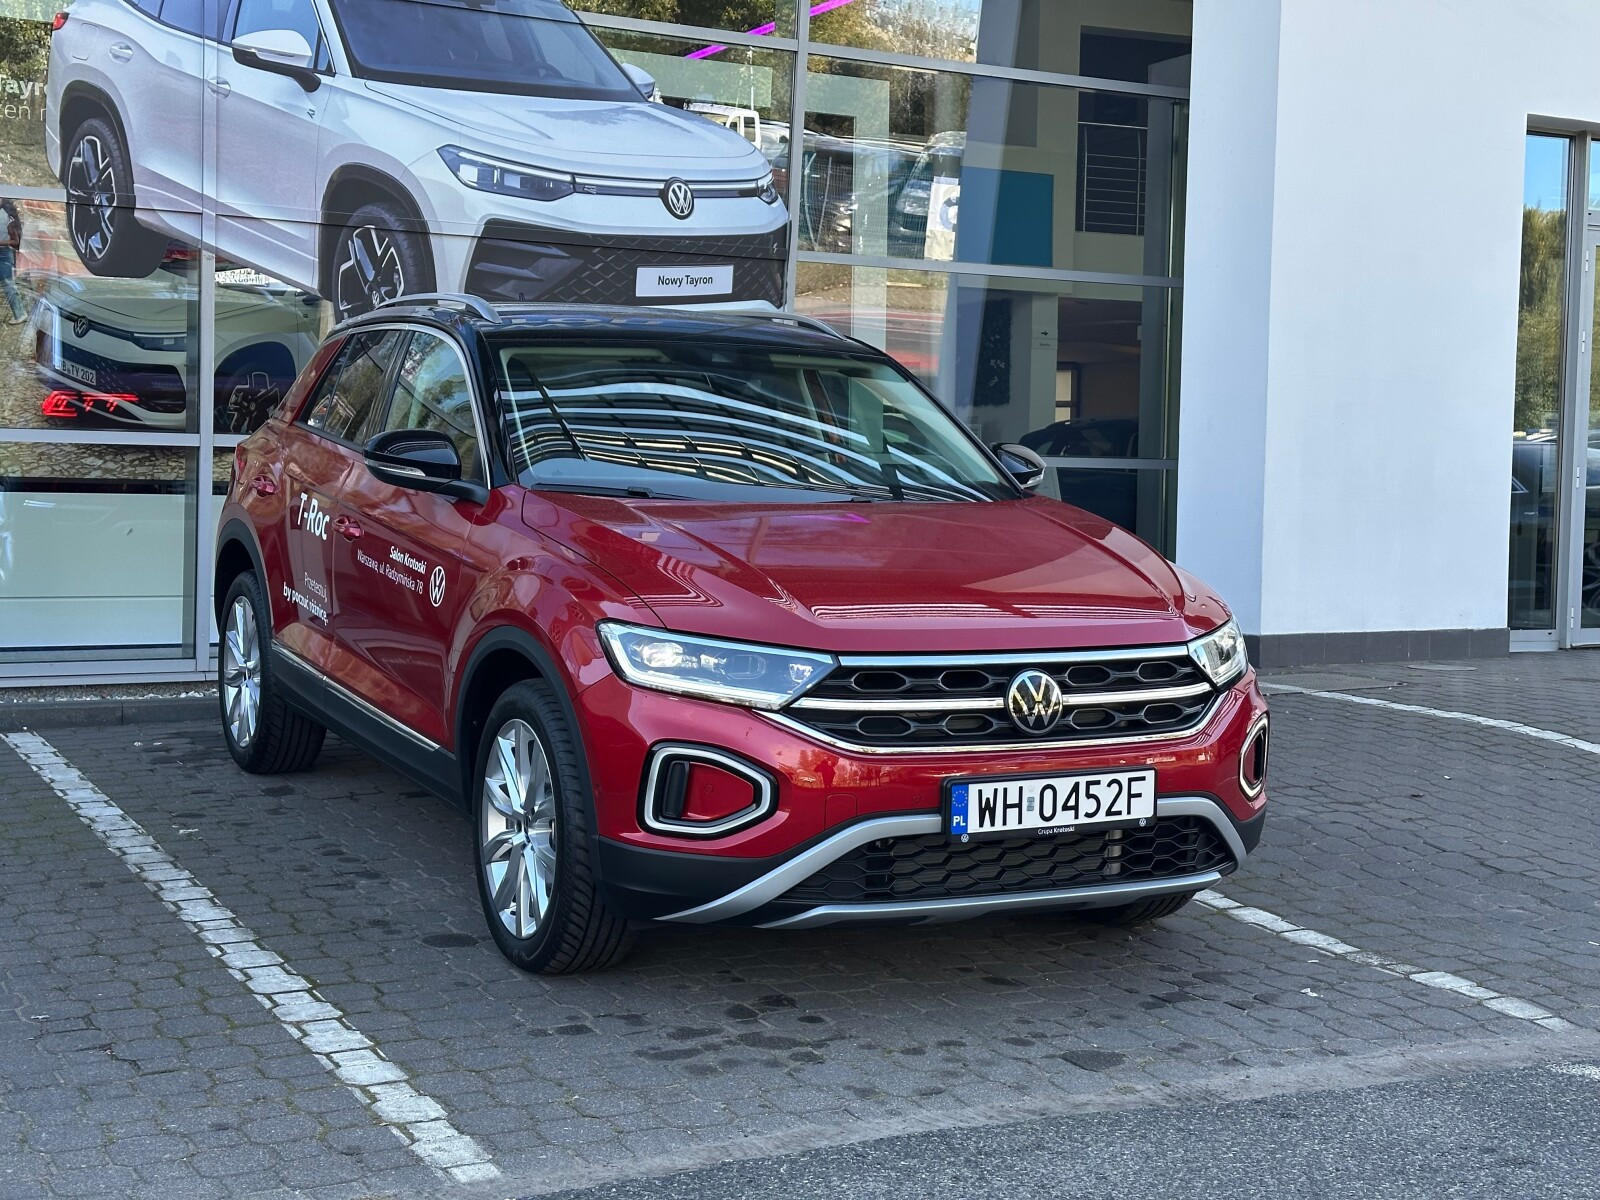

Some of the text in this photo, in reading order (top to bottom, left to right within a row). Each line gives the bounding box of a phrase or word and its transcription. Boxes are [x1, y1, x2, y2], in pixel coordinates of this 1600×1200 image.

[0, 73, 48, 99] ayr
[0, 100, 31, 120] eń
[657, 274, 713, 288] Nowy Tayron
[62, 360, 67, 372] B
[81, 368, 95, 383] 202
[297, 491, 331, 541] T-Roc
[389, 545, 428, 575] Salon Krotoski
[385, 561, 416, 591] Radzymińska
[416, 580, 424, 595] 78
[283, 581, 292, 602] by
[292, 589, 309, 611] poczuć
[977, 775, 1147, 829] WH 0452F
[953, 815, 966, 827] PL
[1037, 826, 1075, 836] Grupa Krotoski
